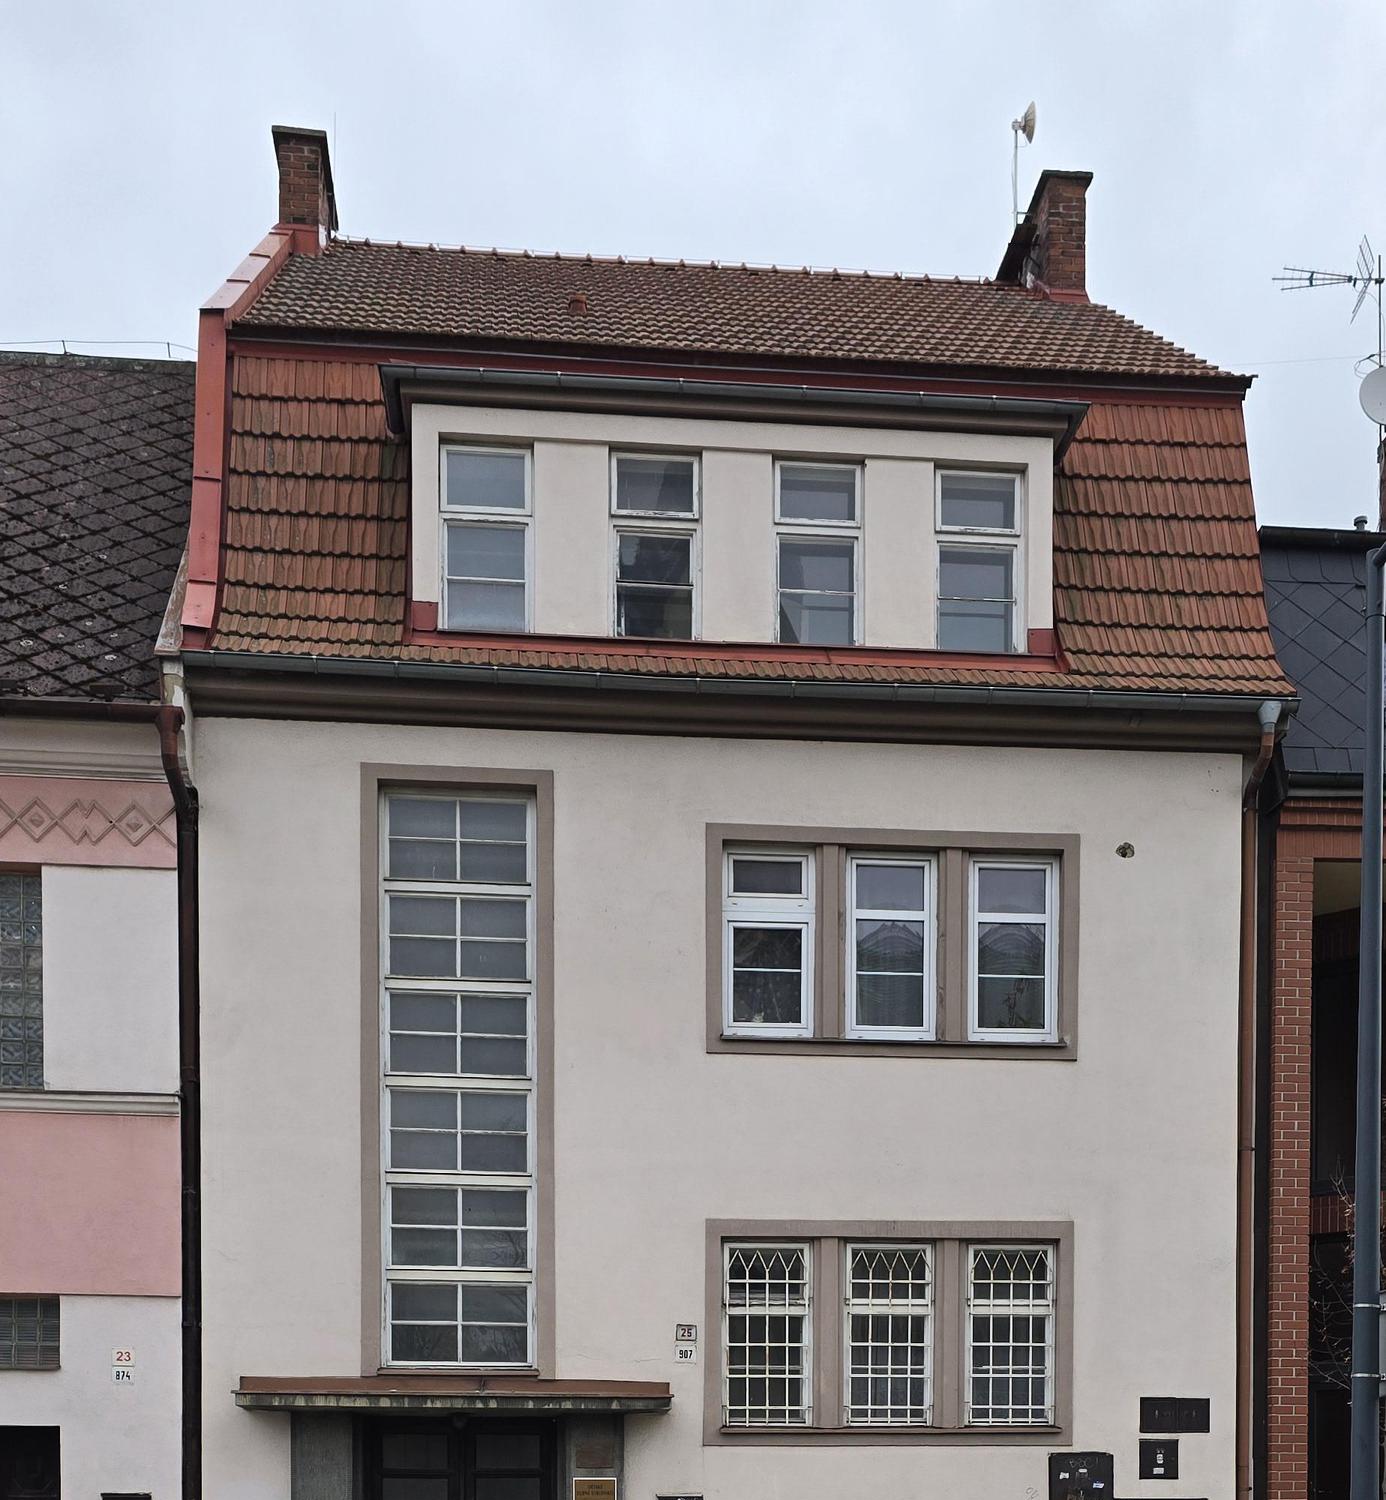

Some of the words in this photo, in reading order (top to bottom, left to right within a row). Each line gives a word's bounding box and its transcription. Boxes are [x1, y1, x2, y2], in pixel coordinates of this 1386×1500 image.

[681, 1328, 692, 1337] 25
[116, 1351, 131, 1361] 23
[679, 1349, 693, 1359] 907
[115, 1370, 130, 1380] 874
